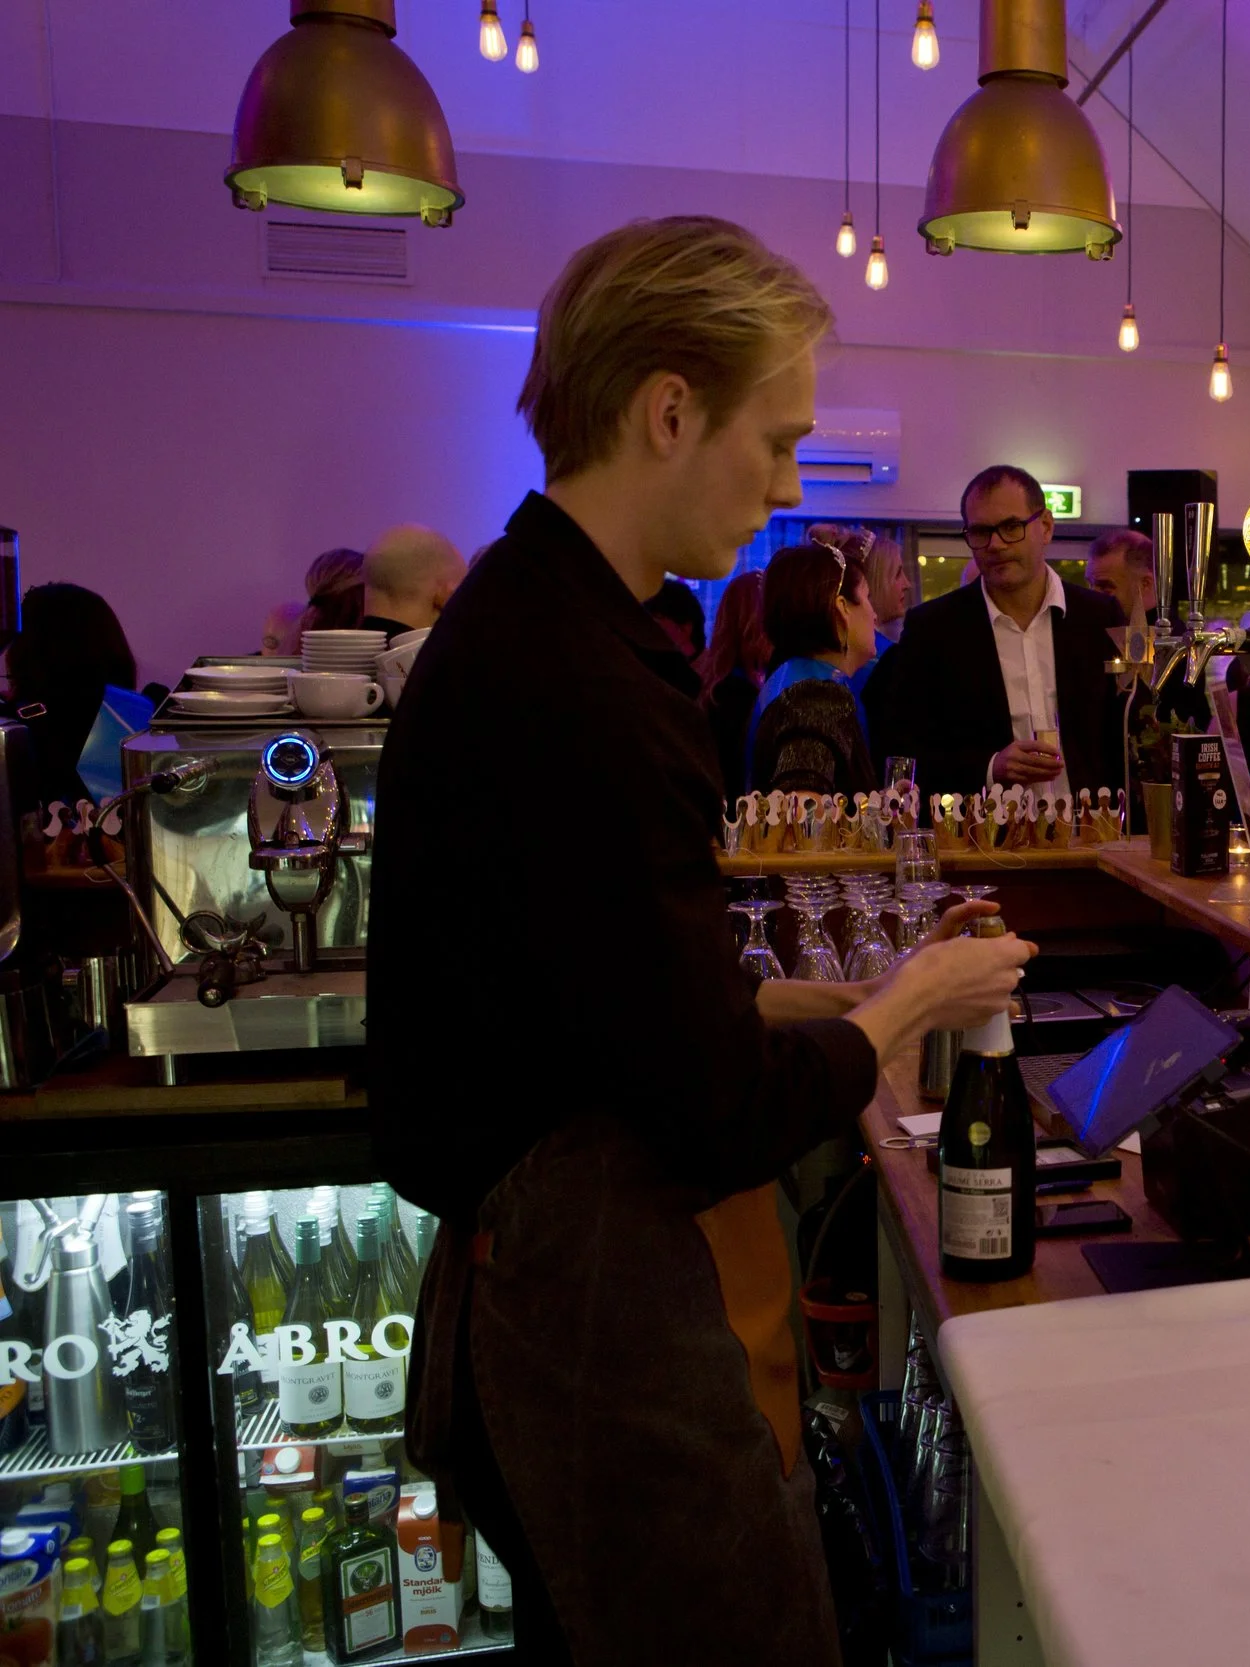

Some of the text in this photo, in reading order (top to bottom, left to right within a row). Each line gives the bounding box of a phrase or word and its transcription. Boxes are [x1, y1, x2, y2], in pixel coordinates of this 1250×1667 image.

[1201, 742, 1219, 753] IRISH
[1198, 752, 1221, 763] COFFEE
[216, 1314, 415, 1375] ÅBRO
[0, 1334, 99, 1386] RO
[403, 1577, 444, 1587] Standar
[412, 1586, 442, 1597] mjölk
